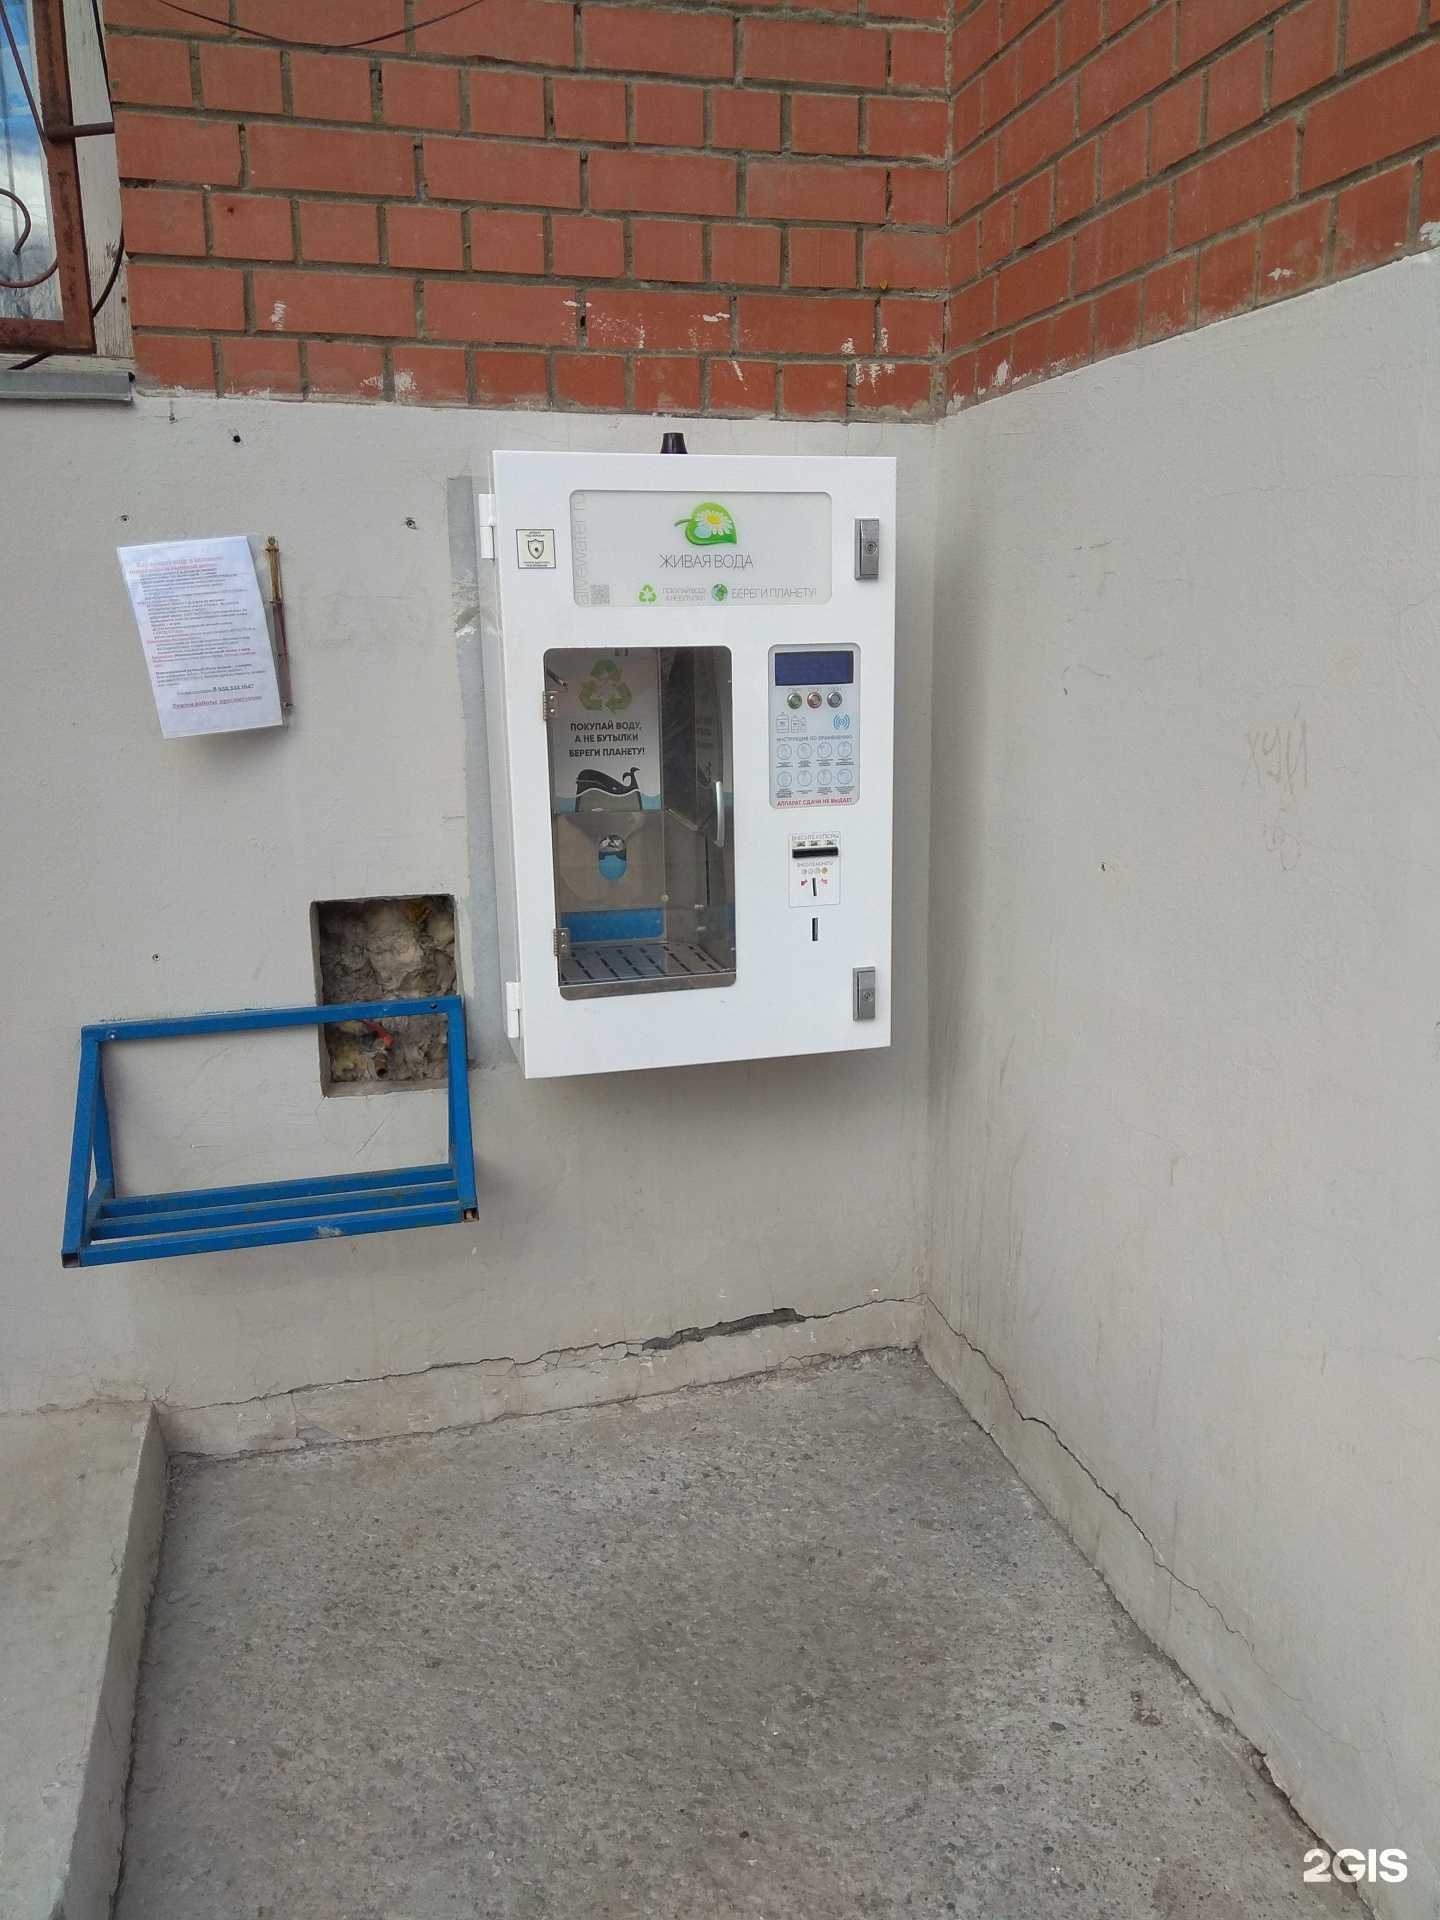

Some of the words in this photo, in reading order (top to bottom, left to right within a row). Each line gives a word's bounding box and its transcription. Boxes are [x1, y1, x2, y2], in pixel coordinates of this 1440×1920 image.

[574, 494, 589, 605] alivewaterru
[659, 553, 711, 569] ЖИВАЯ
[714, 553, 754, 571] ВОДА
[732, 587, 768, 599] БЕРЕГИ
[769, 587, 817, 599] ПЛАНЕТУ!
[570, 720, 614, 731] ПОКУПАЙ
[616, 721, 642, 731] ВОДУ,
[597, 734, 639, 742] БУТЫЛКИ
[568, 749, 601, 757] БЕРЕГИ
[602, 747, 645, 756] ПЛАНЕТУ!
